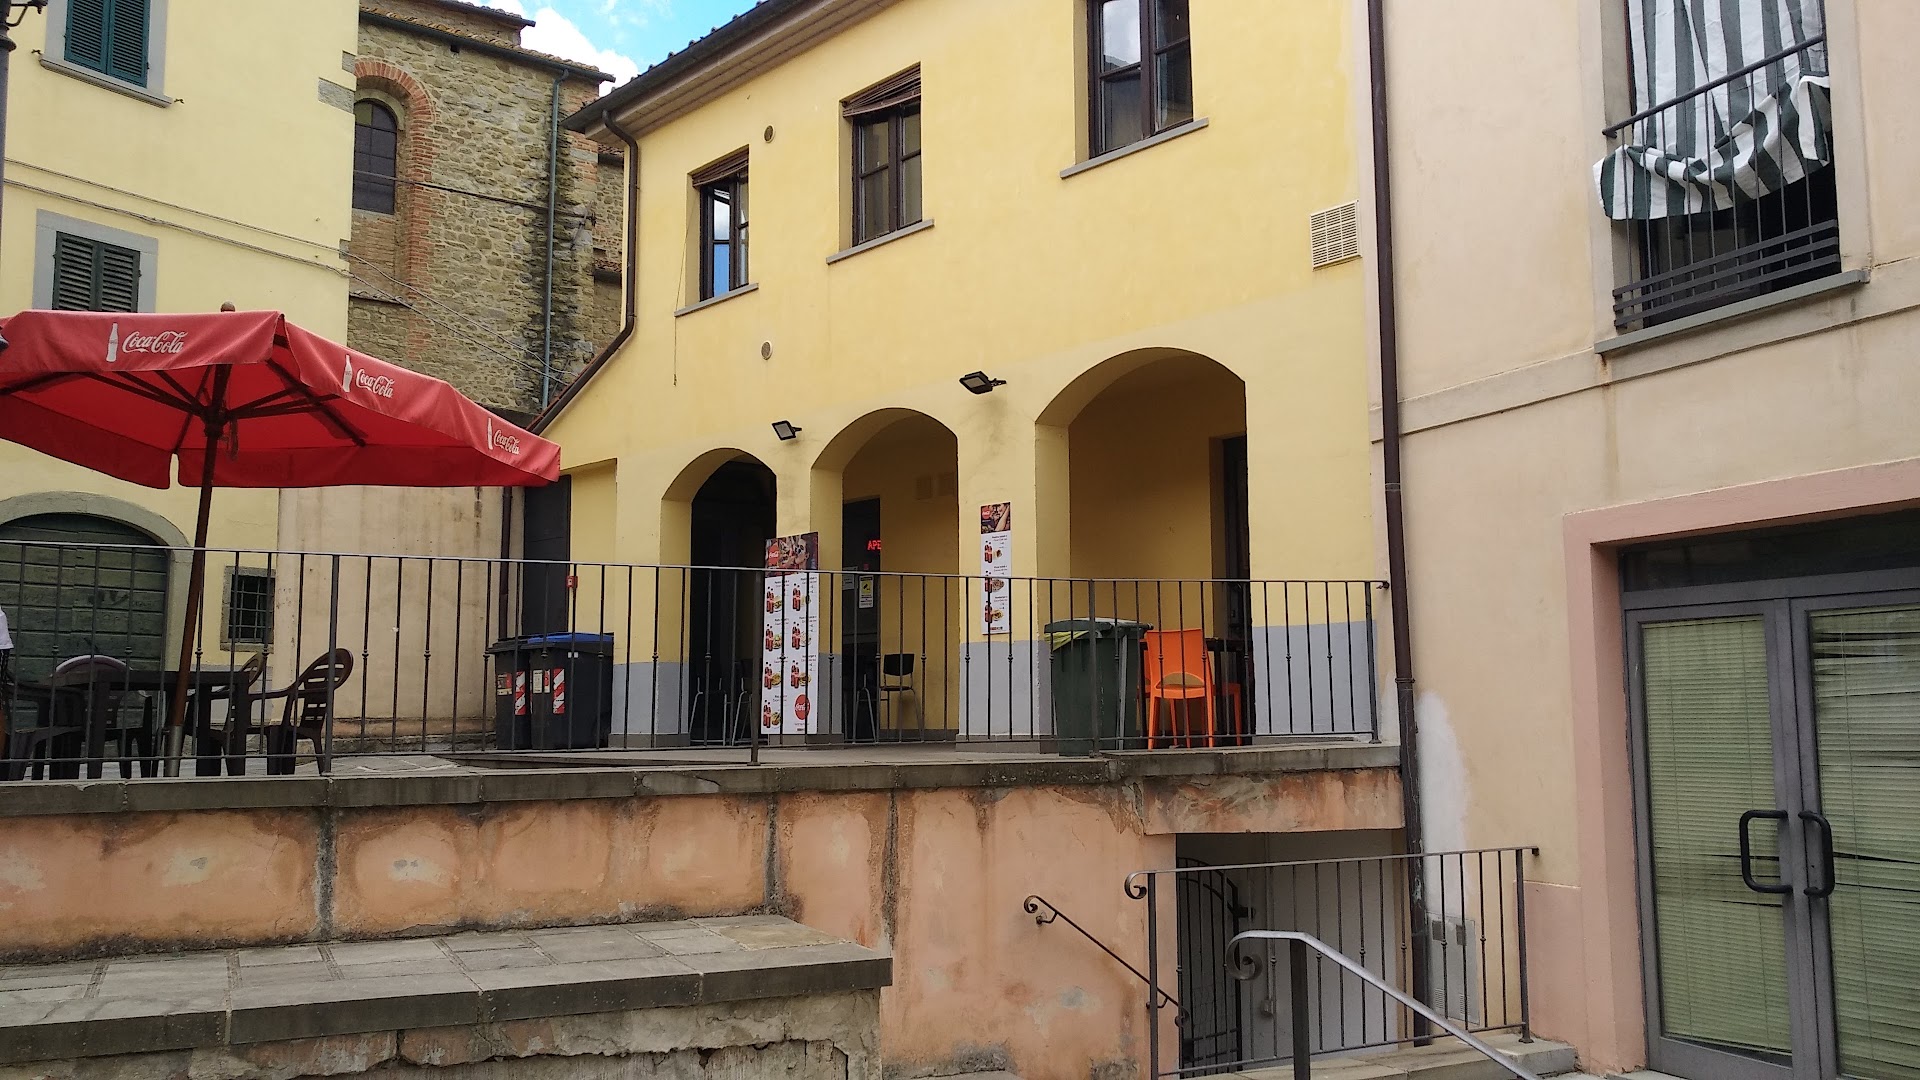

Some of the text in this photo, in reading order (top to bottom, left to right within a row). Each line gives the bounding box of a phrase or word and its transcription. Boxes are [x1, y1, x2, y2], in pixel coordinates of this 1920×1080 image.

[122, 331, 188, 354] Coca-Cola
[356, 368, 395, 398] Coca-Cola
[493, 429, 520, 455] Coca-Cola
